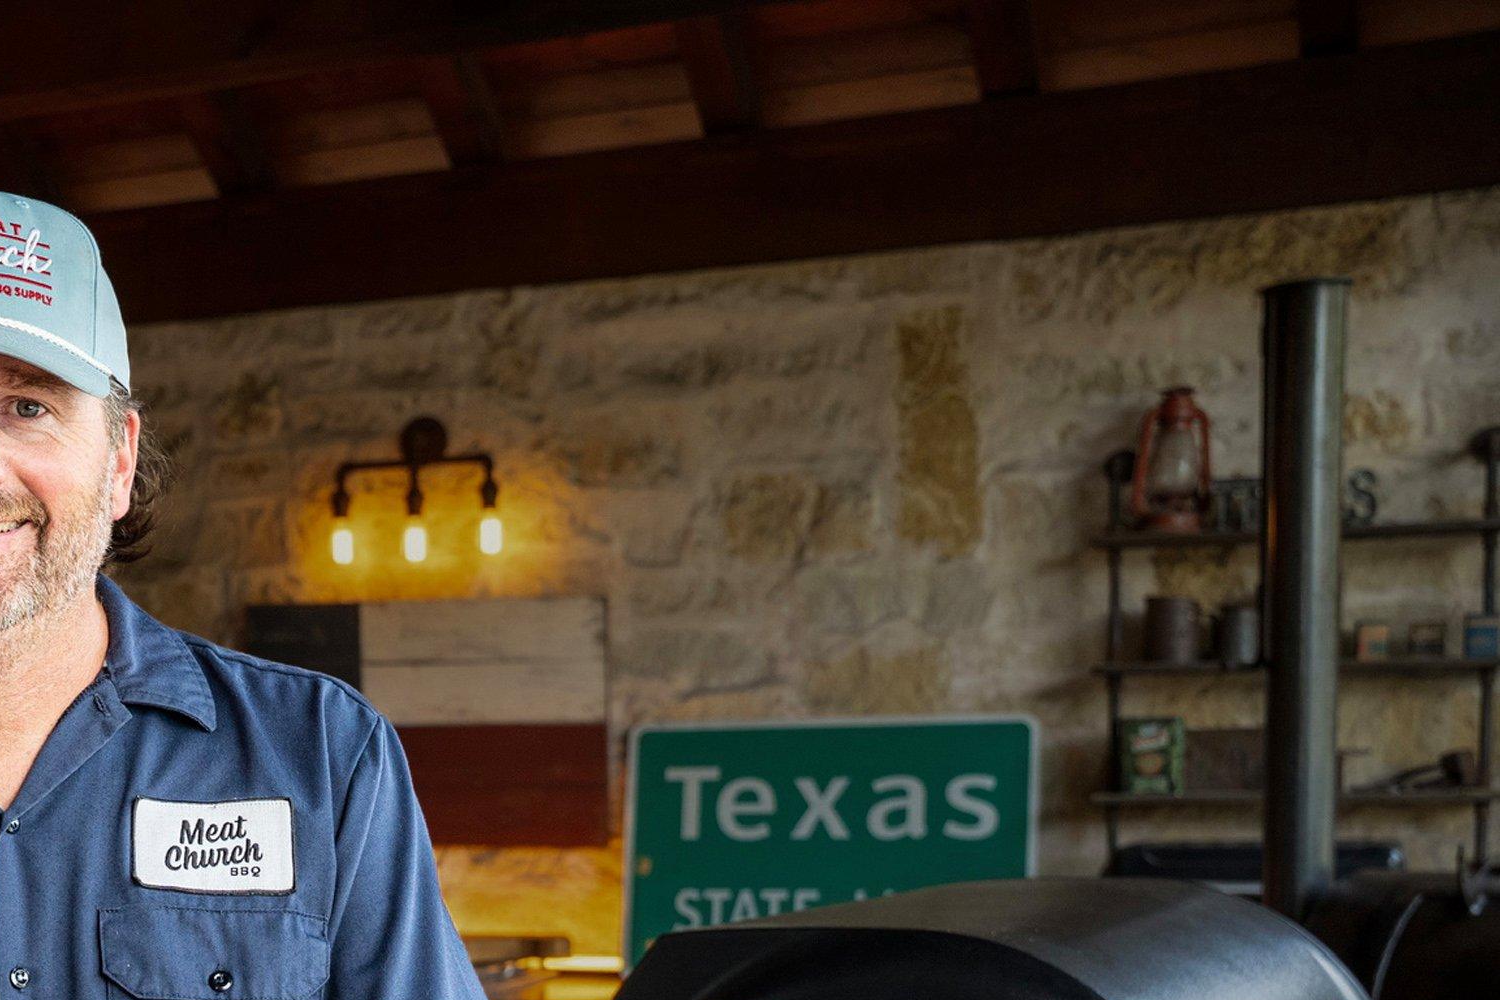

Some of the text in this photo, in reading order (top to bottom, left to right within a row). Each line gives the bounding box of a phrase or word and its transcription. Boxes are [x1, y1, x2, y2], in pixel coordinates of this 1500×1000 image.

[15, 287, 52, 306] SUPPLY
[664, 766, 999, 841] Texas
[180, 815, 247, 845] Meat
[165, 838, 263, 870] Church
[231, 866, 261, 877] BBQ
